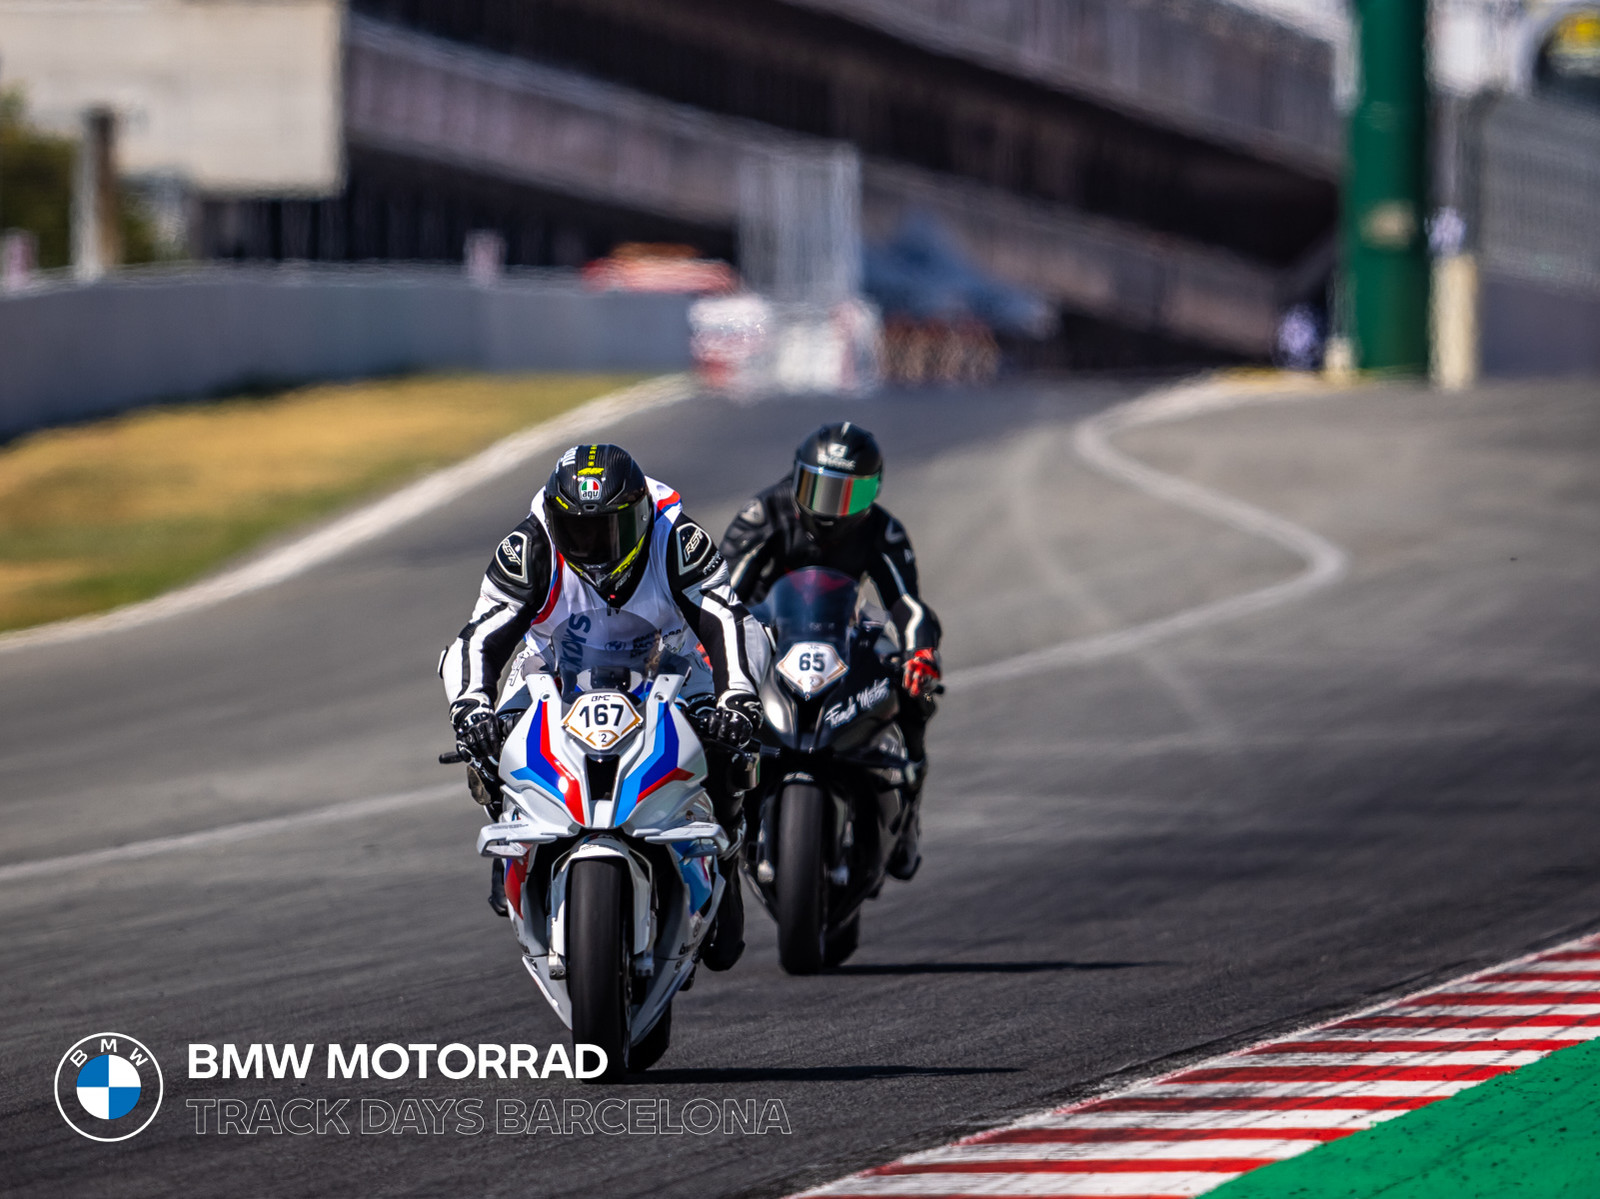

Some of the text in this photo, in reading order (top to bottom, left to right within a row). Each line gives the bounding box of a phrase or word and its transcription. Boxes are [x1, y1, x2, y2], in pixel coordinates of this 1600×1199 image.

[582, 490, 599, 499] agv
[502, 538, 522, 566] RST
[684, 528, 703, 562] RST
[798, 652, 825, 673] 65
[579, 703, 625, 729] 167
[600, 733, 608, 743] 2
